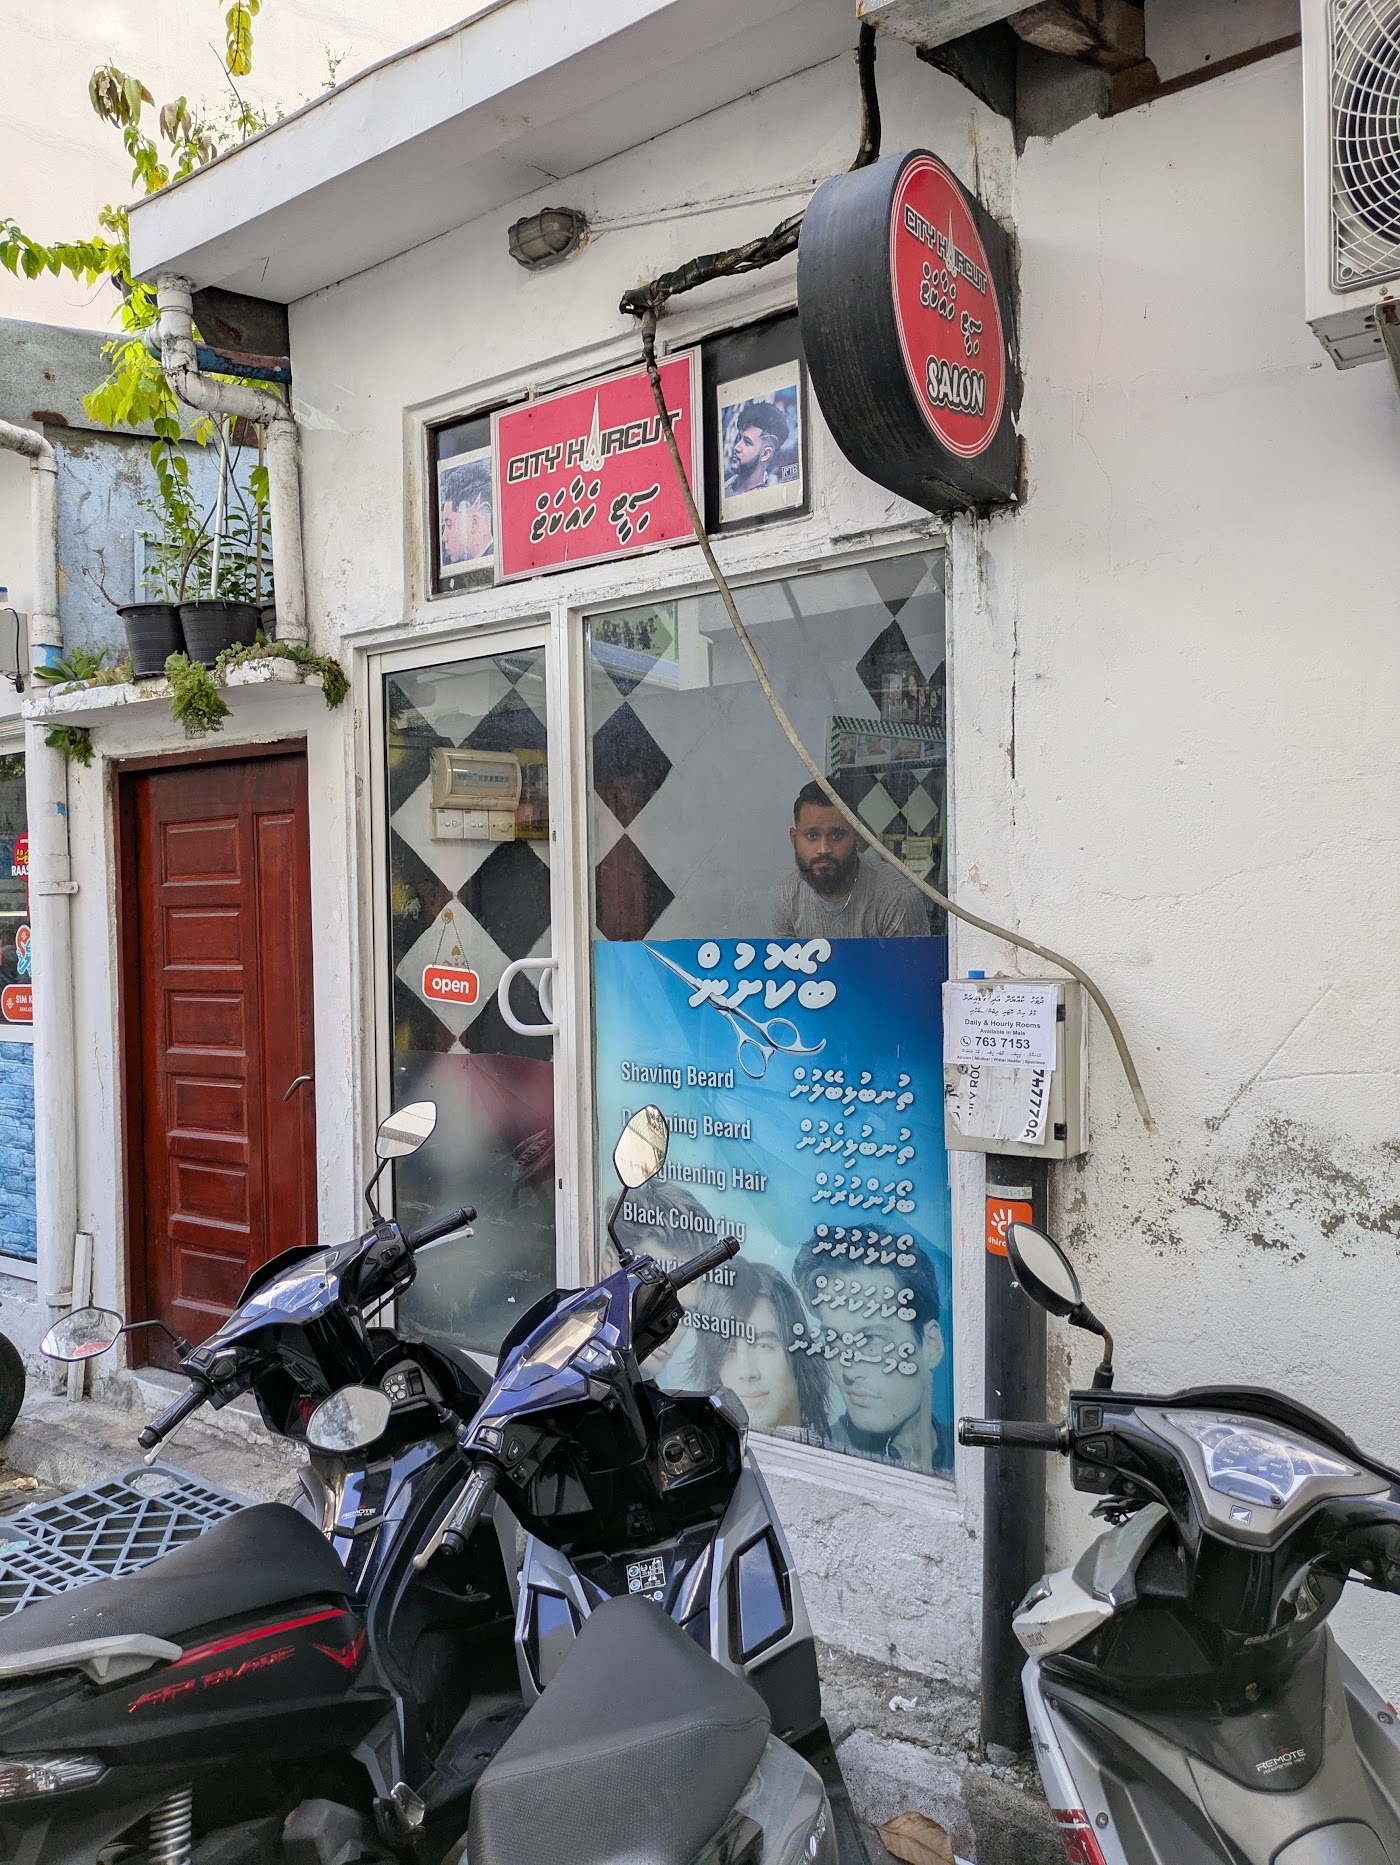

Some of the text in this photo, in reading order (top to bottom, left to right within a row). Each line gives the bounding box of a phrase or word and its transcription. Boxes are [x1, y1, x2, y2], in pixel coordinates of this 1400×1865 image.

[905, 203, 987, 295] CITY HAIRCUT
[926, 355, 986, 416] SALON
[507, 443, 562, 484] CITY
[15, 995, 28, 1004] SIM
[432, 977, 470, 994] open
[964, 1018, 982, 1027] Daily
[990, 1019, 1014, 1029] Hourly
[1015, 1021, 1041, 1029] Rooms
[975, 1036, 1031, 1049] 763 7153
[621, 1061, 734, 1089] Shaving Beard
[622, 1108, 751, 1140] Dning Beard
[732, 1167, 768, 1192] Hair
[623, 1201, 746, 1243] Black Colouring
[679, 1310, 756, 1344] assaging
[1255, 1748, 1307, 1772] REMOTE
